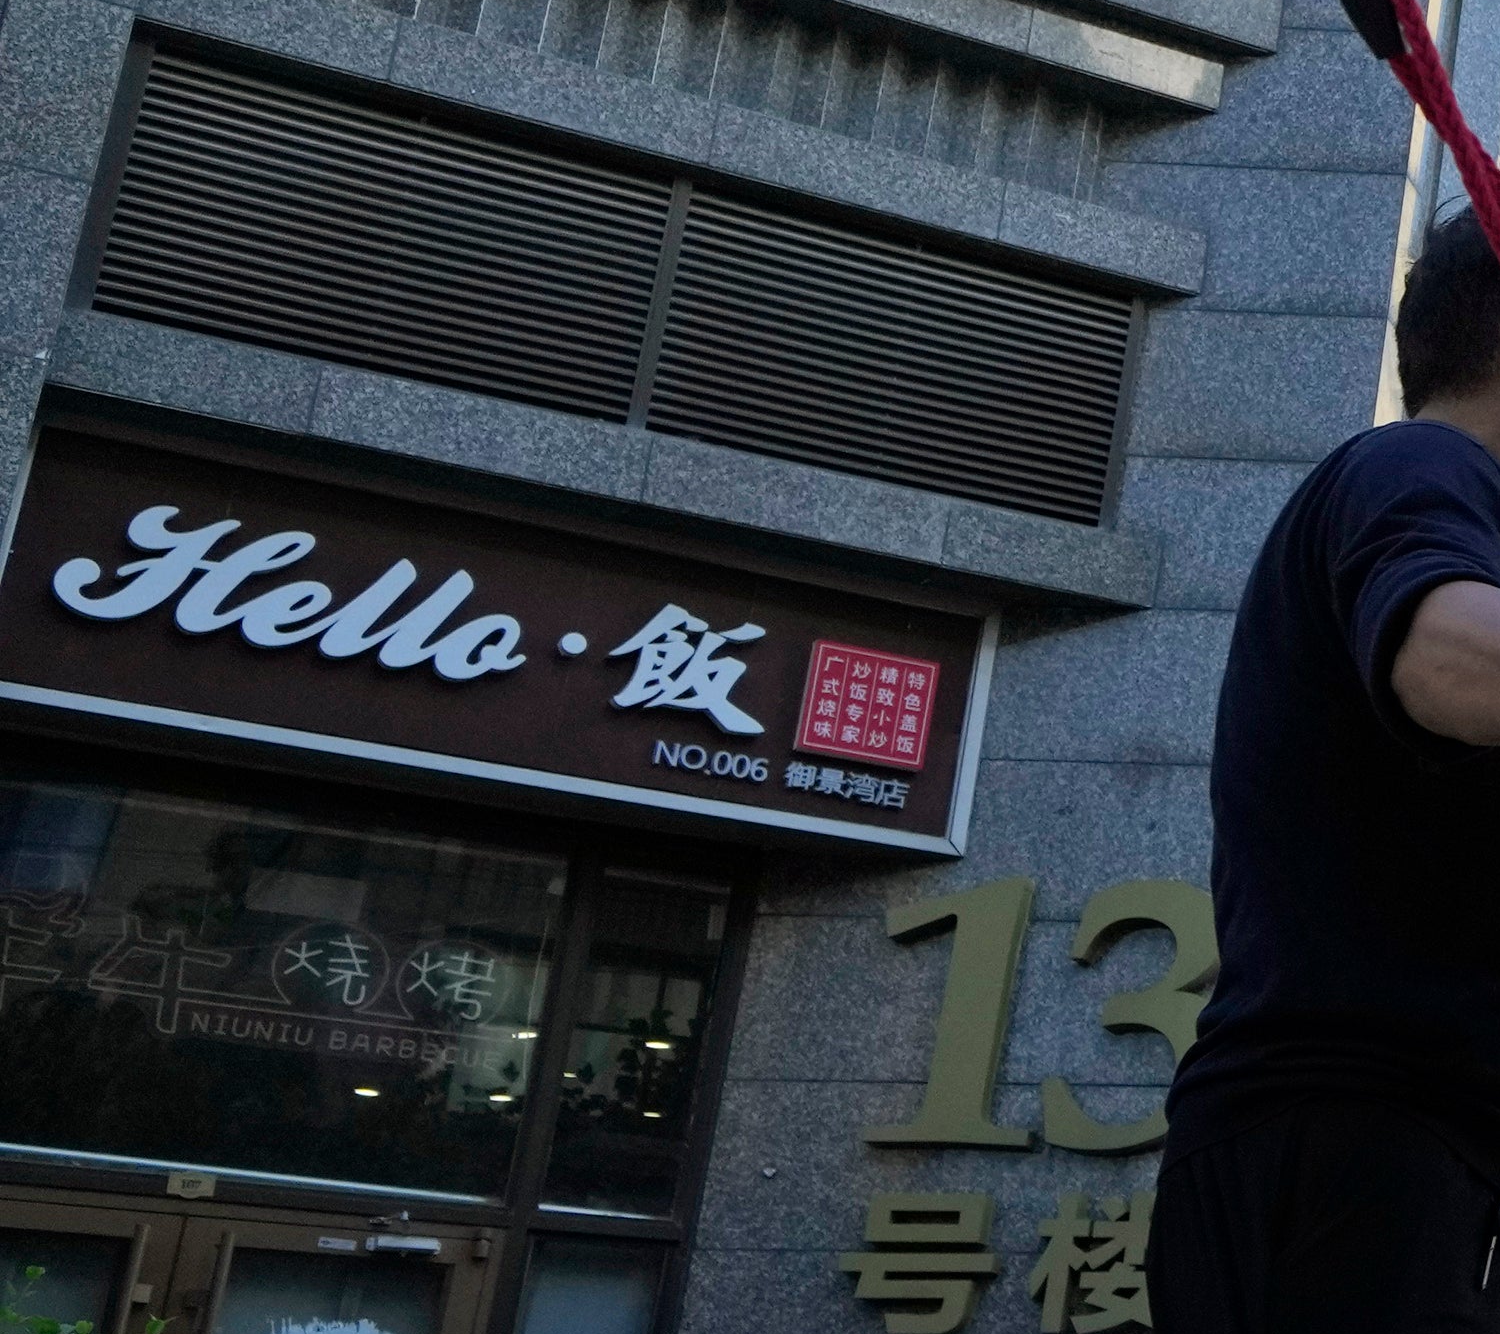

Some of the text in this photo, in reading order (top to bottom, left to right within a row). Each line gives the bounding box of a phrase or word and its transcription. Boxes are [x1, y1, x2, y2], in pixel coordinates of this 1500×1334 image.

[53, 505, 526, 681] Hello
[813, 656, 845, 738] 广式烧味
[841, 661, 872, 744] 炒饭专家
[867, 667, 899, 748] 精致小炒
[896, 671, 926, 754] 特色盖饭
[653, 739, 911, 810] NO.006 御景湾店
[191, 1011, 503, 1073] NIUNIU BARBECUE
[862, 875, 1220, 1153] 13
